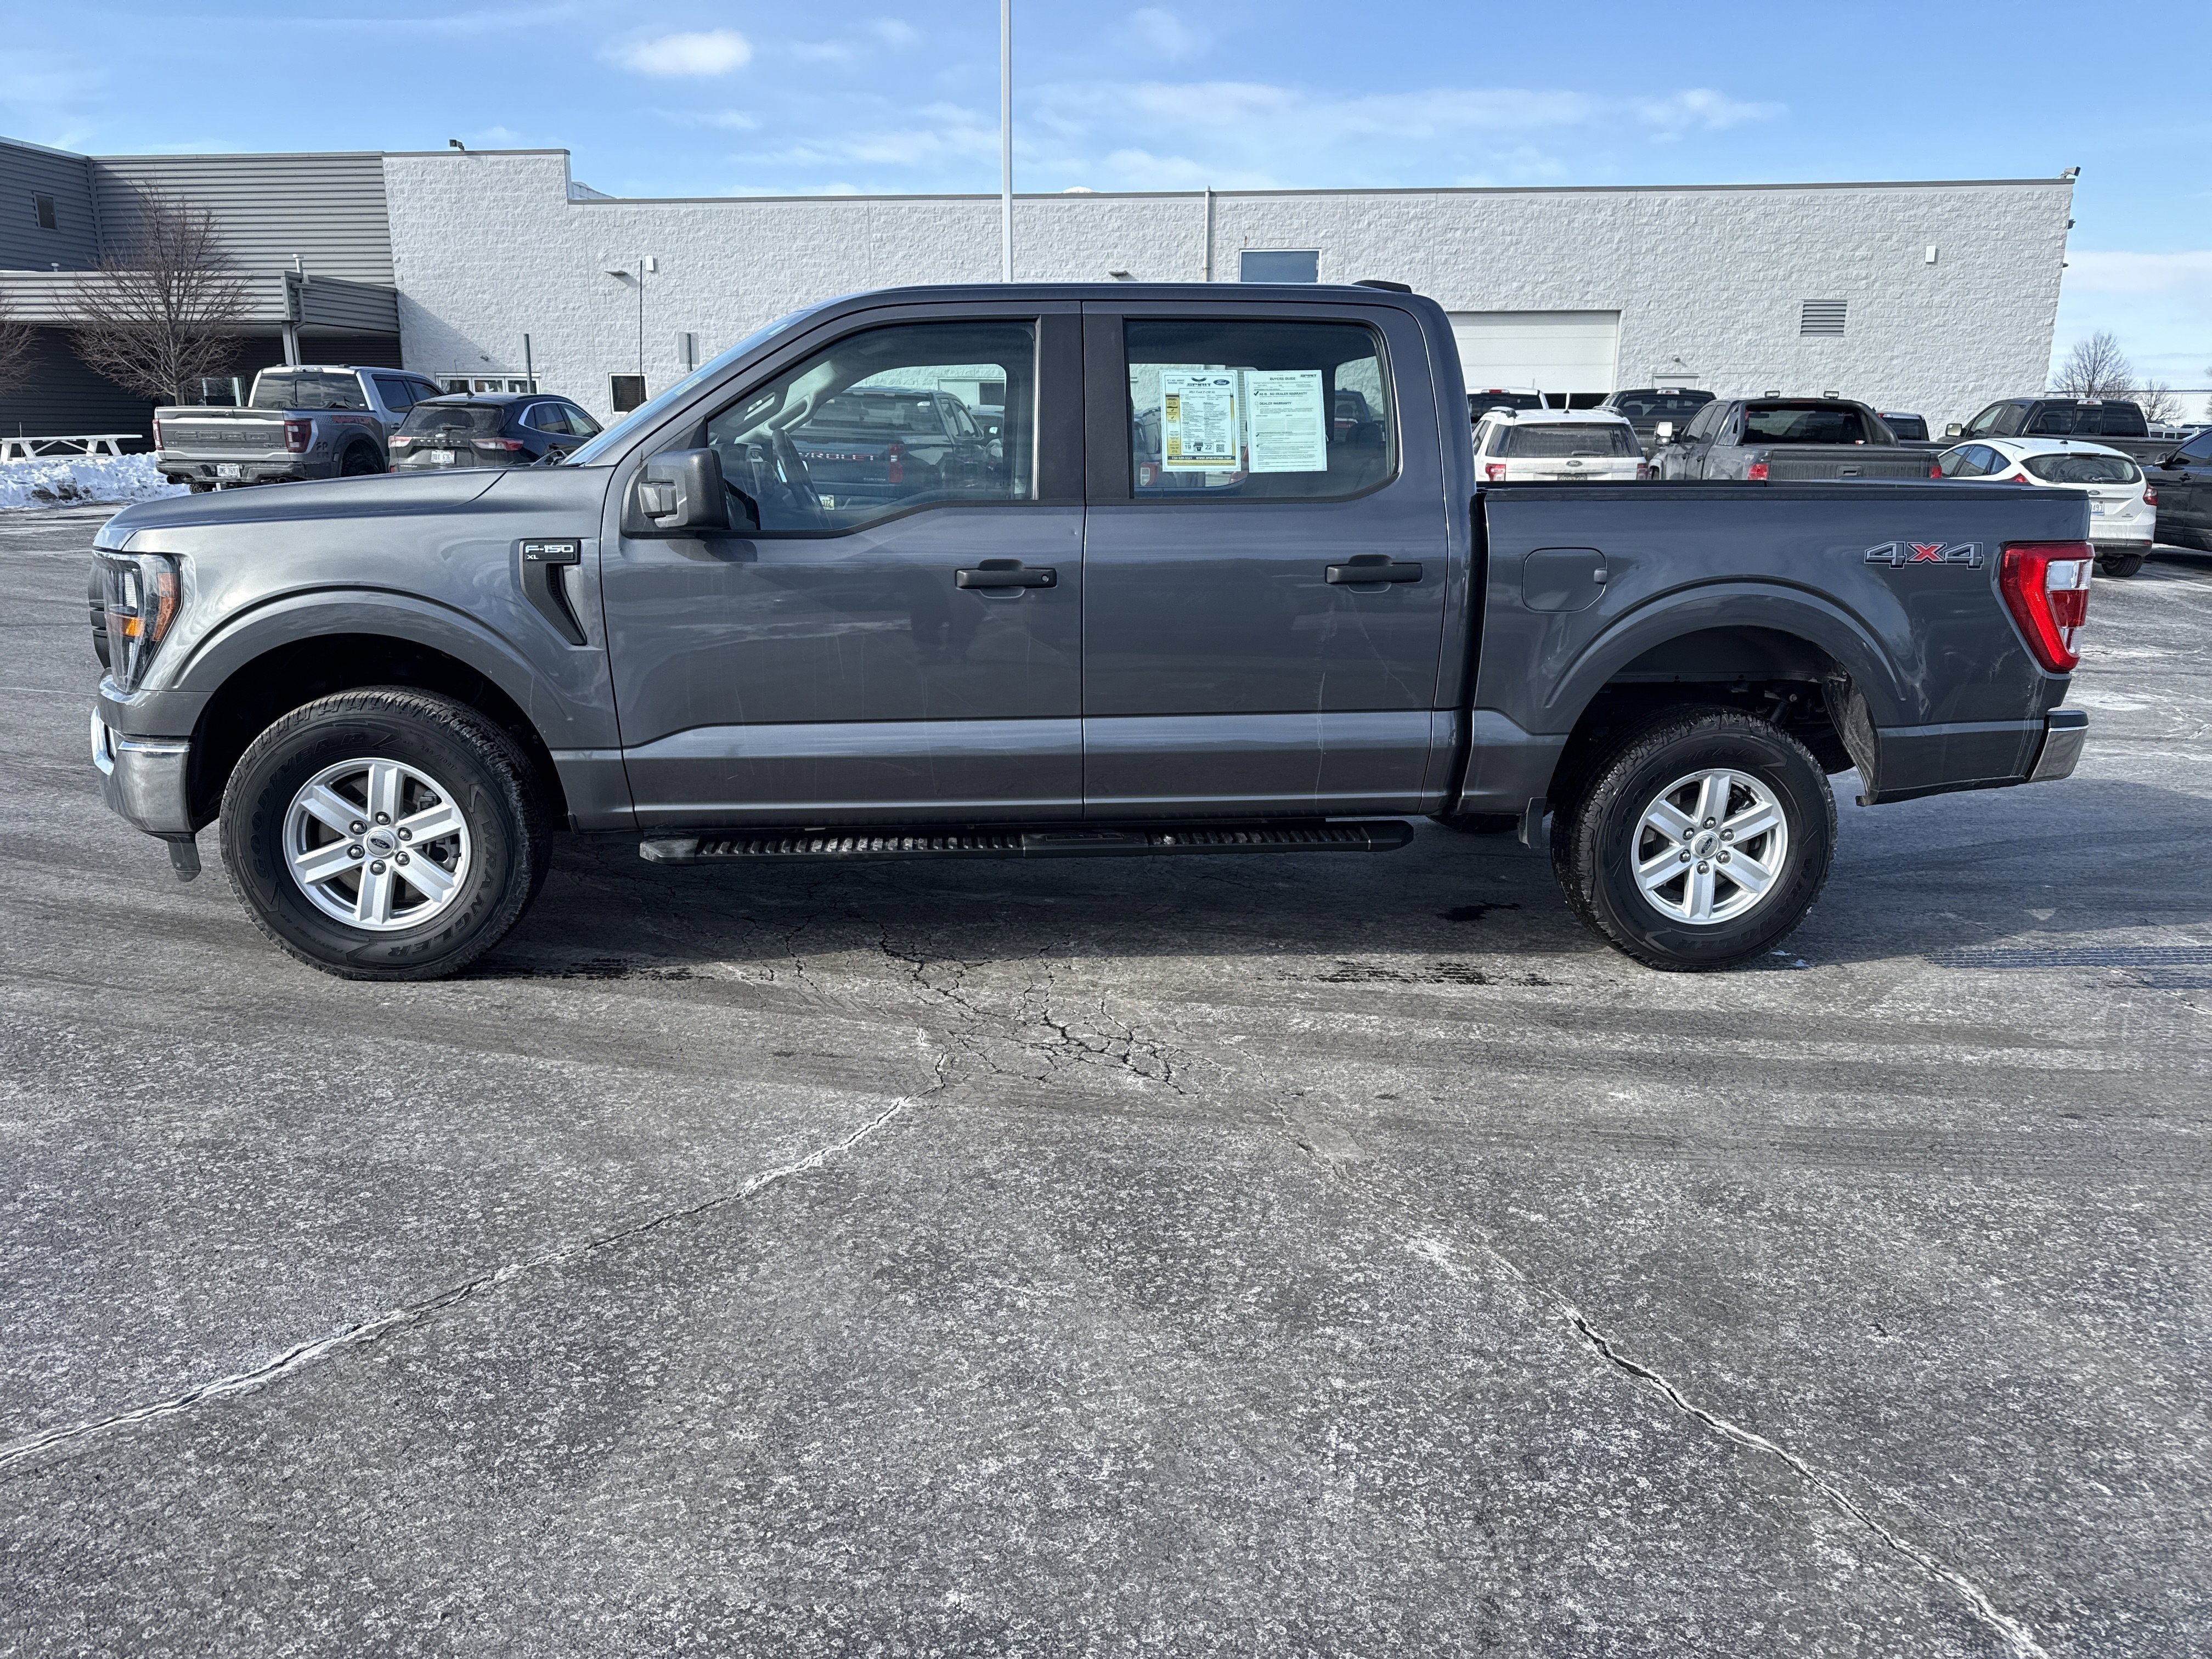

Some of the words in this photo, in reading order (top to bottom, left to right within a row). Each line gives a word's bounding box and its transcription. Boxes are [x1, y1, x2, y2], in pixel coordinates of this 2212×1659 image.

[173, 431, 271, 441] FORD
[798, 452, 879, 461] VROLET
[525, 545, 574, 554] F-150
[250, 733, 364, 879] GOODYEAR
[387, 820, 496, 957] WRANGLER
